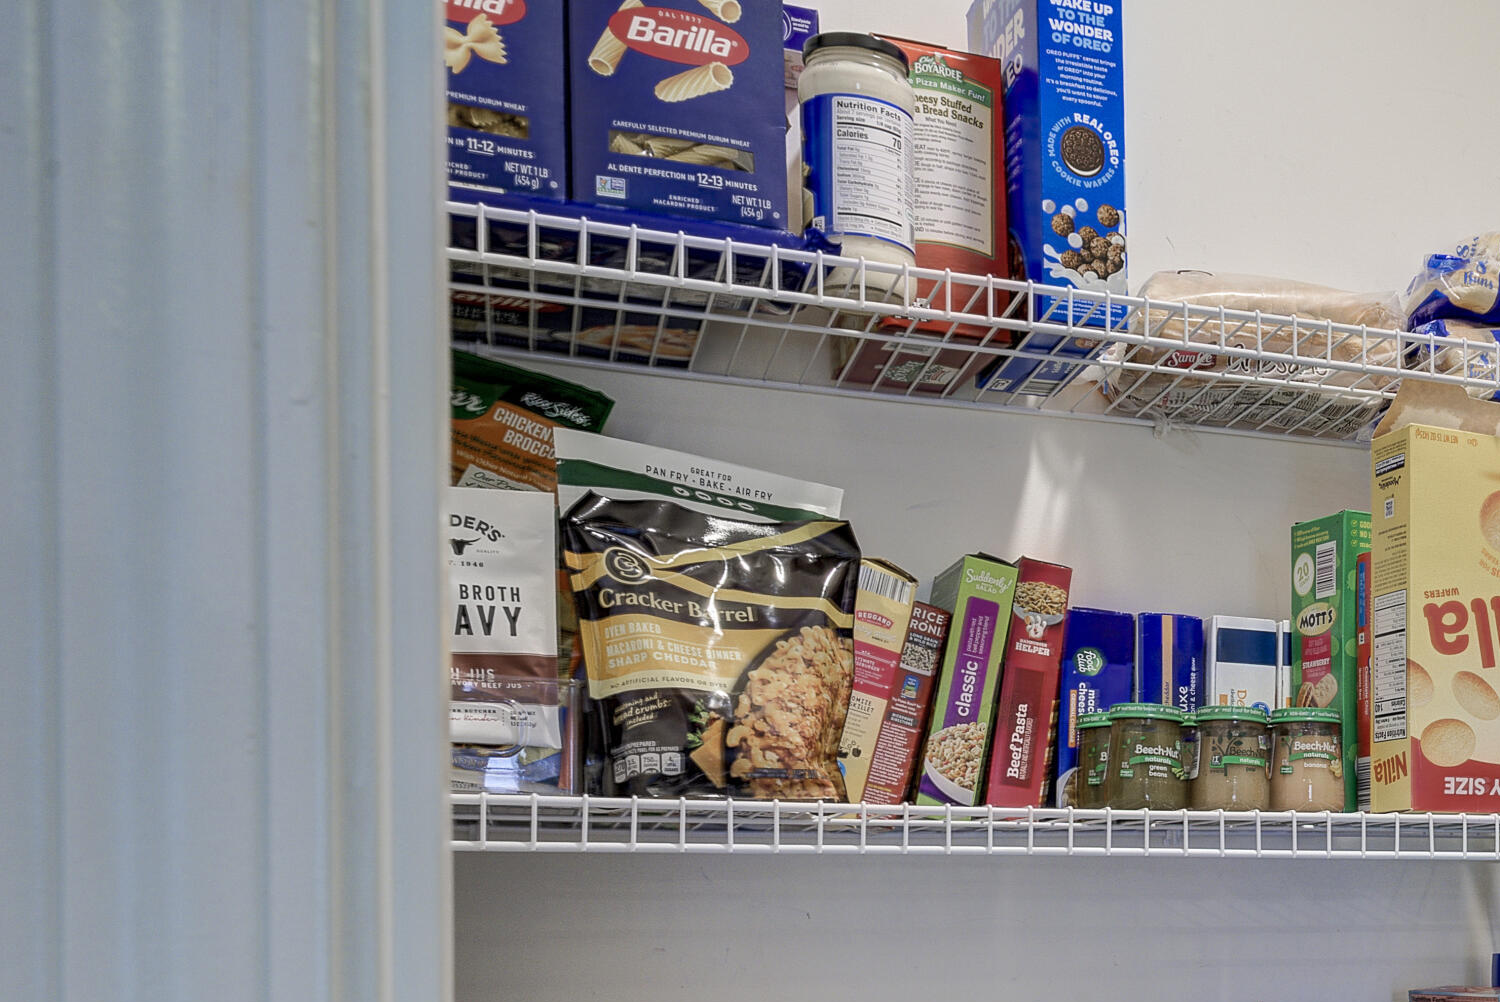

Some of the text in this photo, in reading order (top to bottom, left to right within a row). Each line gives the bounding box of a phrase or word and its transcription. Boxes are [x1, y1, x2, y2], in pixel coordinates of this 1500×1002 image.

[1057, 7, 1105, 28] TO THE
[1093, 2, 1114, 16] UP
[627, 15, 732, 58] Barilla
[1048, 17, 1114, 42] WONDER
[1051, 31, 1111, 53] OF OREO
[914, 62, 963, 83] BOYARDEE
[915, 77, 985, 102] Pizza Maker Fun!
[504, 101, 526, 111] WHEAT
[836, 100, 878, 114] Nutrition
[880, 106, 901, 121] Facts
[940, 97, 972, 115] Stuffed
[923, 105, 984, 130] Bread Snacks
[613, 120, 751, 148] CAREFULLY SELECTED PREMIUM DURUM WHEAT
[836, 129, 869, 140] Calories
[1053, 112, 1120, 166] WITH REAL OREO
[467, 138, 535, 159] 11-12 MINUTES
[619, 164, 758, 192] DENTE PERFECTION 12-13 MINUTES
[1051, 160, 1115, 189] COOKIE WAFERS
[654, 198, 715, 212] MACARONI PRODUCT
[1170, 350, 1196, 367] Sara
[492, 406, 551, 443] CHICKEN
[503, 428, 557, 460] BROCCO
[645, 464, 773, 502] PAN FRY BAKE AIR FRY
[690, 466, 732, 482] GREAT FOR
[461, 560, 485, 568] 1946
[1297, 561, 1309, 582] 20
[459, 584, 521, 602] BROTH
[975, 584, 998, 594] SALAD
[1423, 587, 1460, 599] WAFERS
[598, 588, 755, 623] Cracker Barrel
[912, 606, 945, 625] RICE
[454, 604, 522, 637] AVY
[603, 621, 662, 639] OVEN BAKED
[909, 619, 942, 637] RONI
[605, 638, 742, 662] MACARONI CHEESE DINNER
[1015, 641, 1051, 657] HELPER
[607, 650, 717, 670] SHARP CHEDDAR
[1083, 650, 1097, 672] food
[1302, 657, 1331, 670] STRAWBERRY
[621, 676, 695, 688] ARTIFICIAL FLAVORS
[952, 660, 979, 717] classic
[1011, 703, 1028, 744] Pasta
[1134, 744, 1179, 759] Beech-Nut
[1294, 741, 1336, 753] Beech-Nut
[1303, 752, 1330, 760] naturals
[1006, 743, 1023, 779] Beef
[1144, 756, 1172, 765] naturals
[1373, 751, 1408, 786] Nilla
[1443, 776, 1486, 795] SIZE
